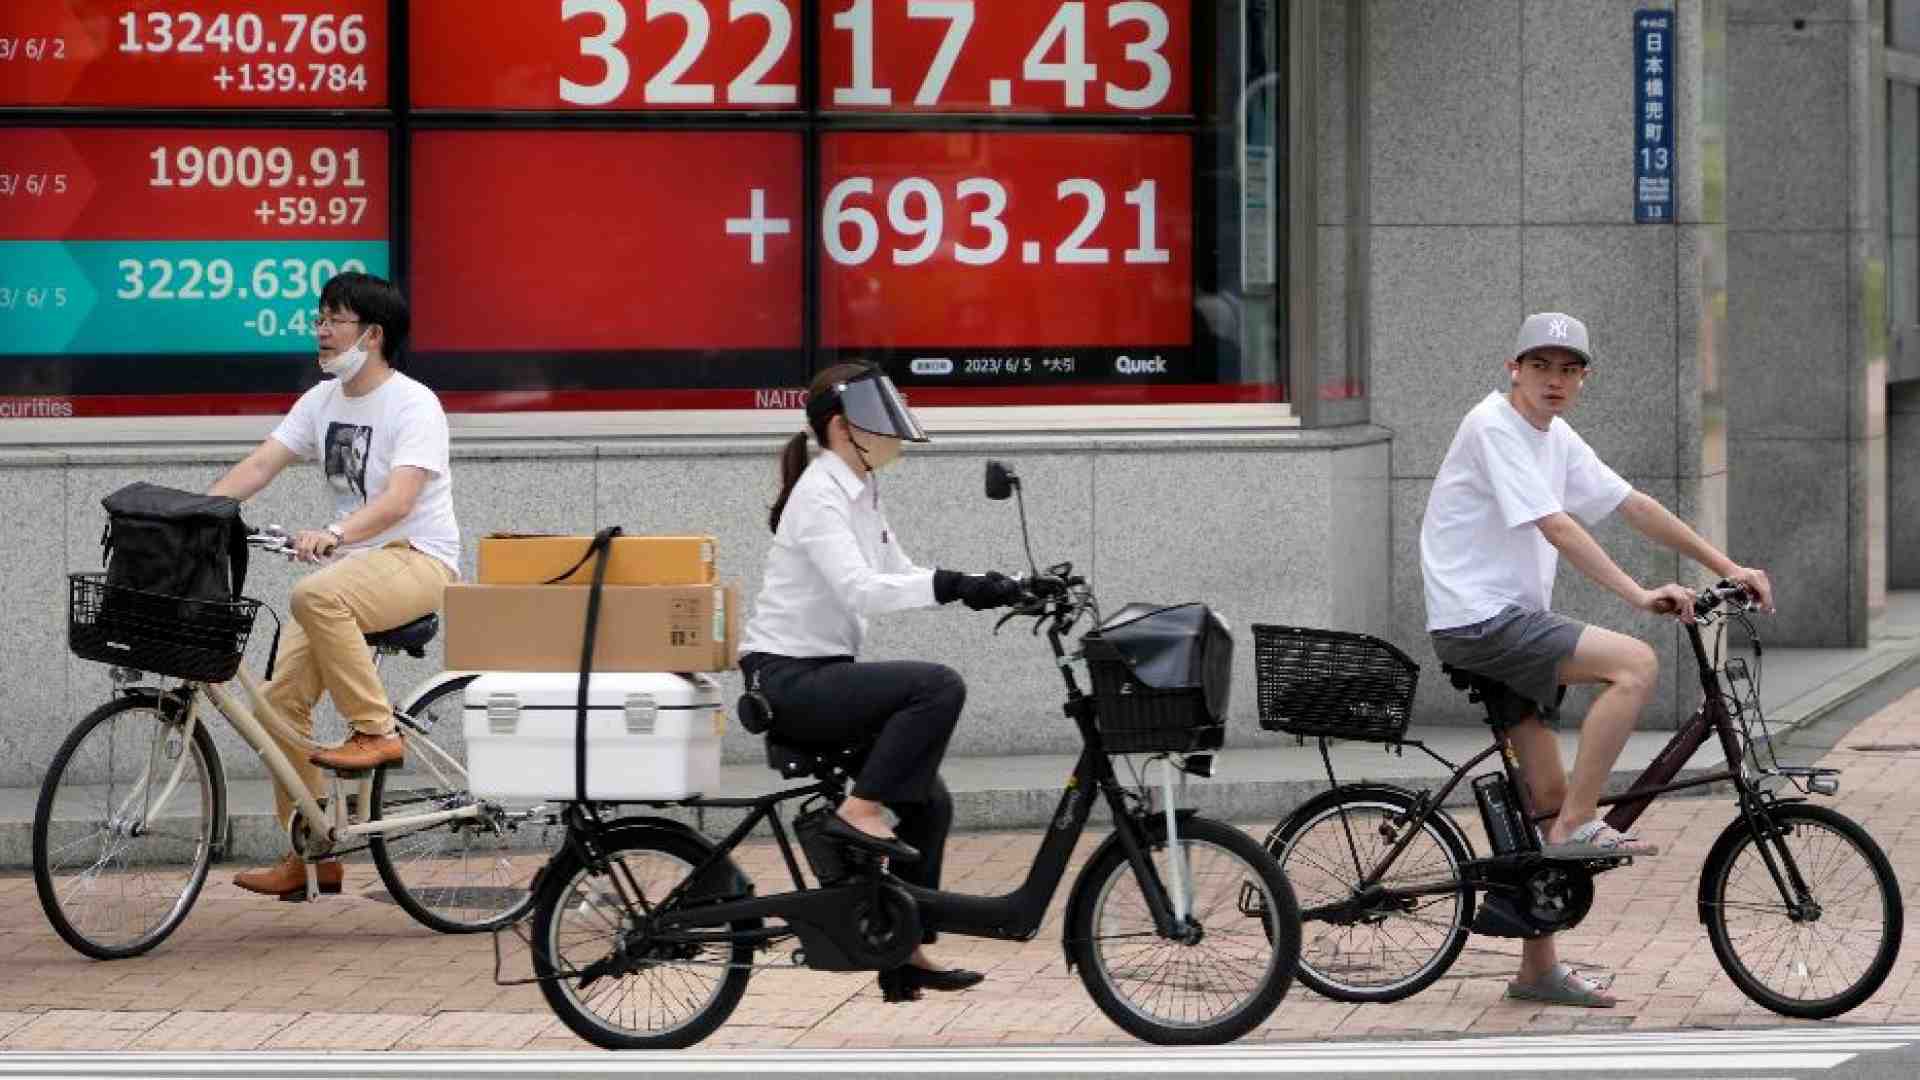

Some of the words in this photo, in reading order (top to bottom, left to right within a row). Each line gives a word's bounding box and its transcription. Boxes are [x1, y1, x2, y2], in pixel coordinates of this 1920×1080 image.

[118, 12, 366, 54] 13240.766
[54, 38, 65, 58] 2
[213, 64, 366, 92] +139.784
[149, 146, 365, 187] 19009.91
[1640, 147, 1668, 170] 13
[55, 174, 67, 193] 5
[255, 197, 367, 225] +59.97
[117, 258, 367, 300] 3229.630
[55, 288, 67, 307] 5
